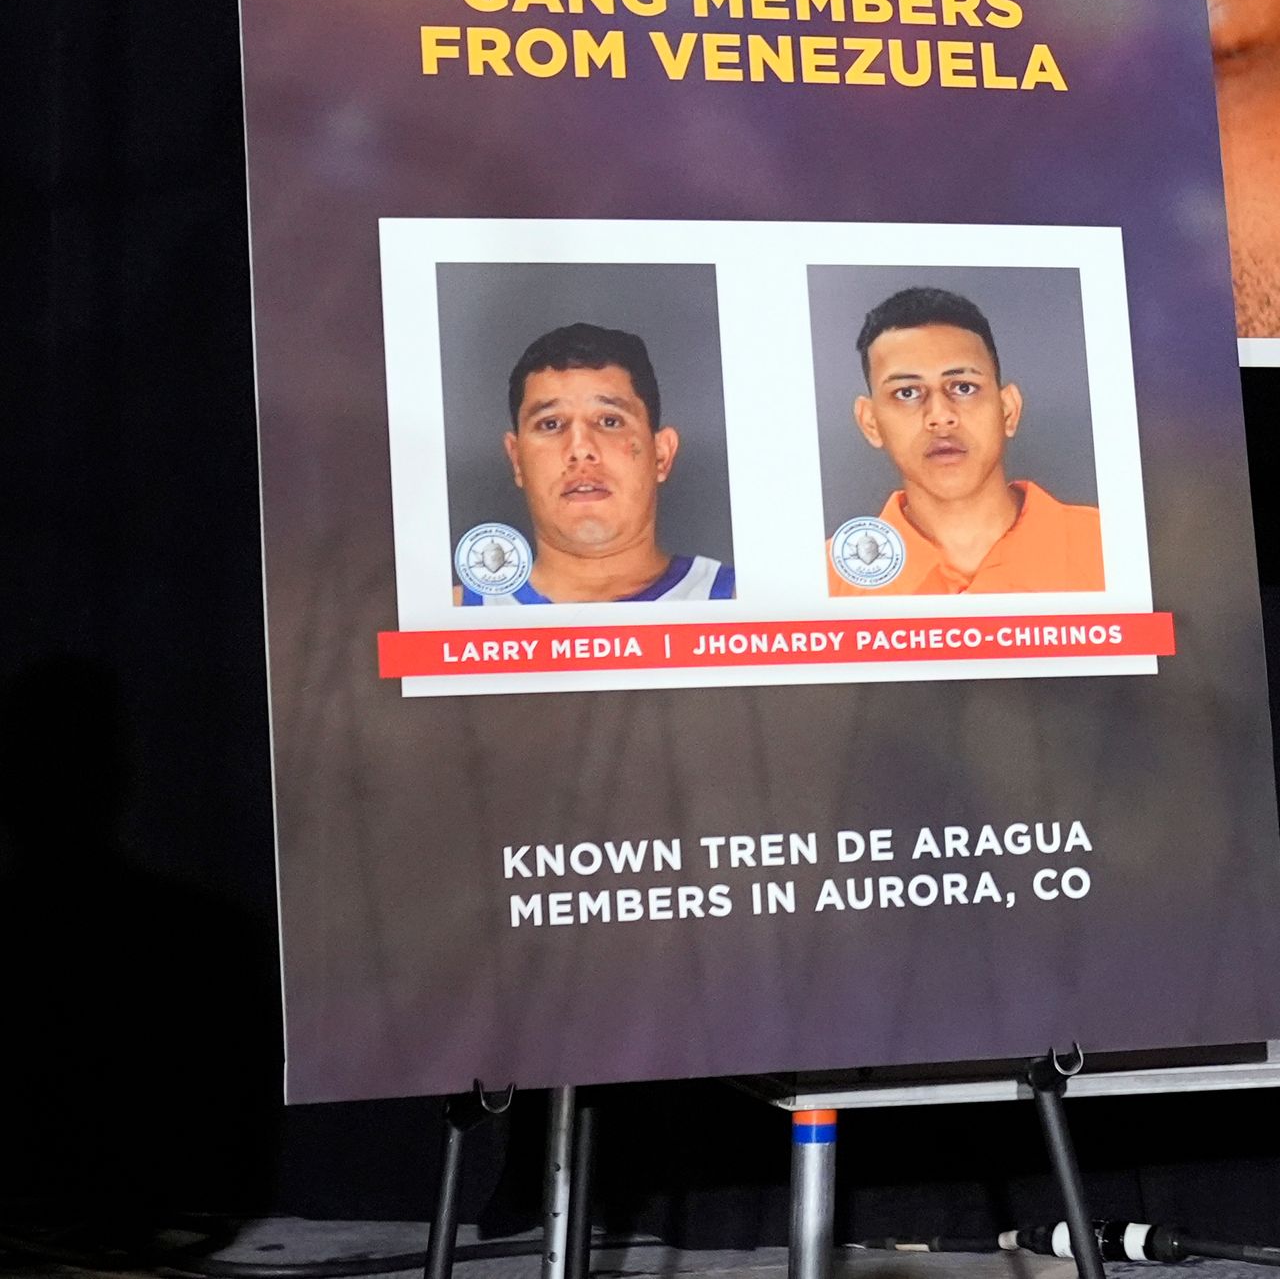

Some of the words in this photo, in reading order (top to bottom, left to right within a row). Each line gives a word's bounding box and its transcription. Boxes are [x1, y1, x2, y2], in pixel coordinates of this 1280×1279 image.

[420, 25, 627, 79] FROM
[648, 31, 1068, 91] VENEZUELA
[443, 640, 539, 663] LARRY
[551, 637, 643, 659] MEDIA
[692, 631, 844, 655] JHONARDY
[856, 624, 1123, 650] PACHECO-CHIRINOS
[503, 838, 682, 879] KNOWN
[700, 832, 818, 869] TREN
[837, 829, 894, 863] DE
[912, 820, 1093, 860] ARAGUA
[510, 884, 733, 927] MEMBERS
[751, 881, 796, 915] IN
[815, 871, 1015, 912] AURORA,
[1032, 867, 1091, 901] CO
